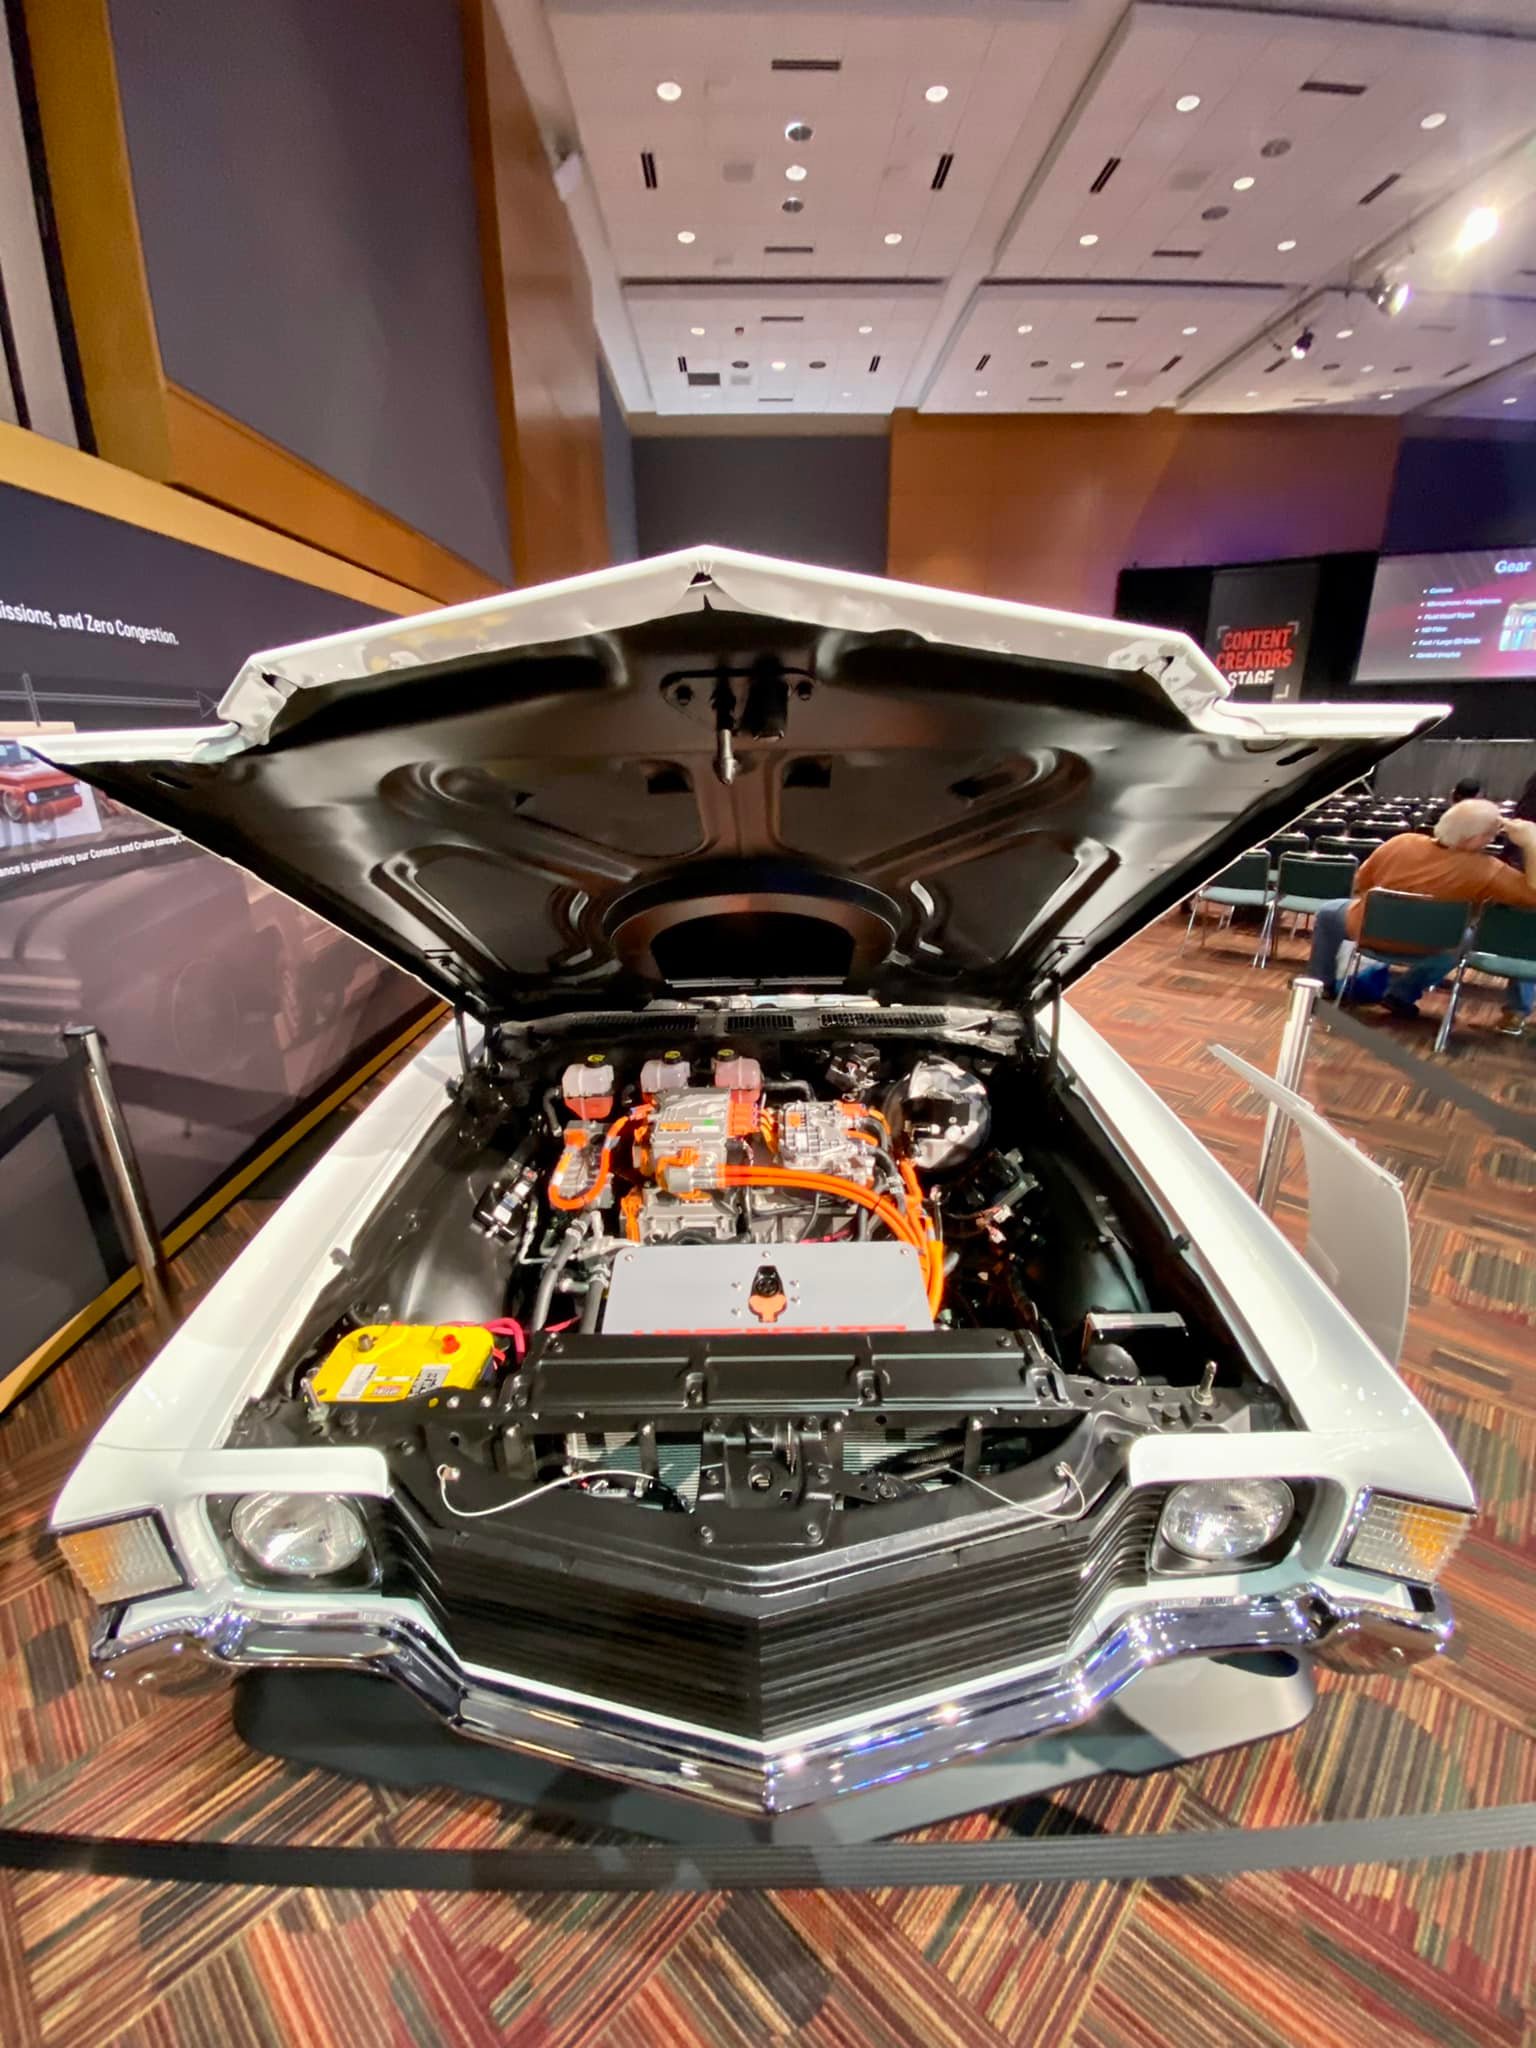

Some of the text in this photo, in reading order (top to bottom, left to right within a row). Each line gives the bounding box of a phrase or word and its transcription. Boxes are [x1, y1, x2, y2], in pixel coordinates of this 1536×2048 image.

[1494, 559, 1532, 574] Gear
[0, 601, 179, 645] issions, and Zero Congestion.
[1223, 627, 1292, 650] CONTENT
[1216, 648, 1293, 671] CREATORS
[20, 861, 31, 873] is
[30, 854, 77, 874] pioneering
[76, 851, 90, 862] our
[89, 845, 121, 860] Connect
[121, 842, 134, 854] and
